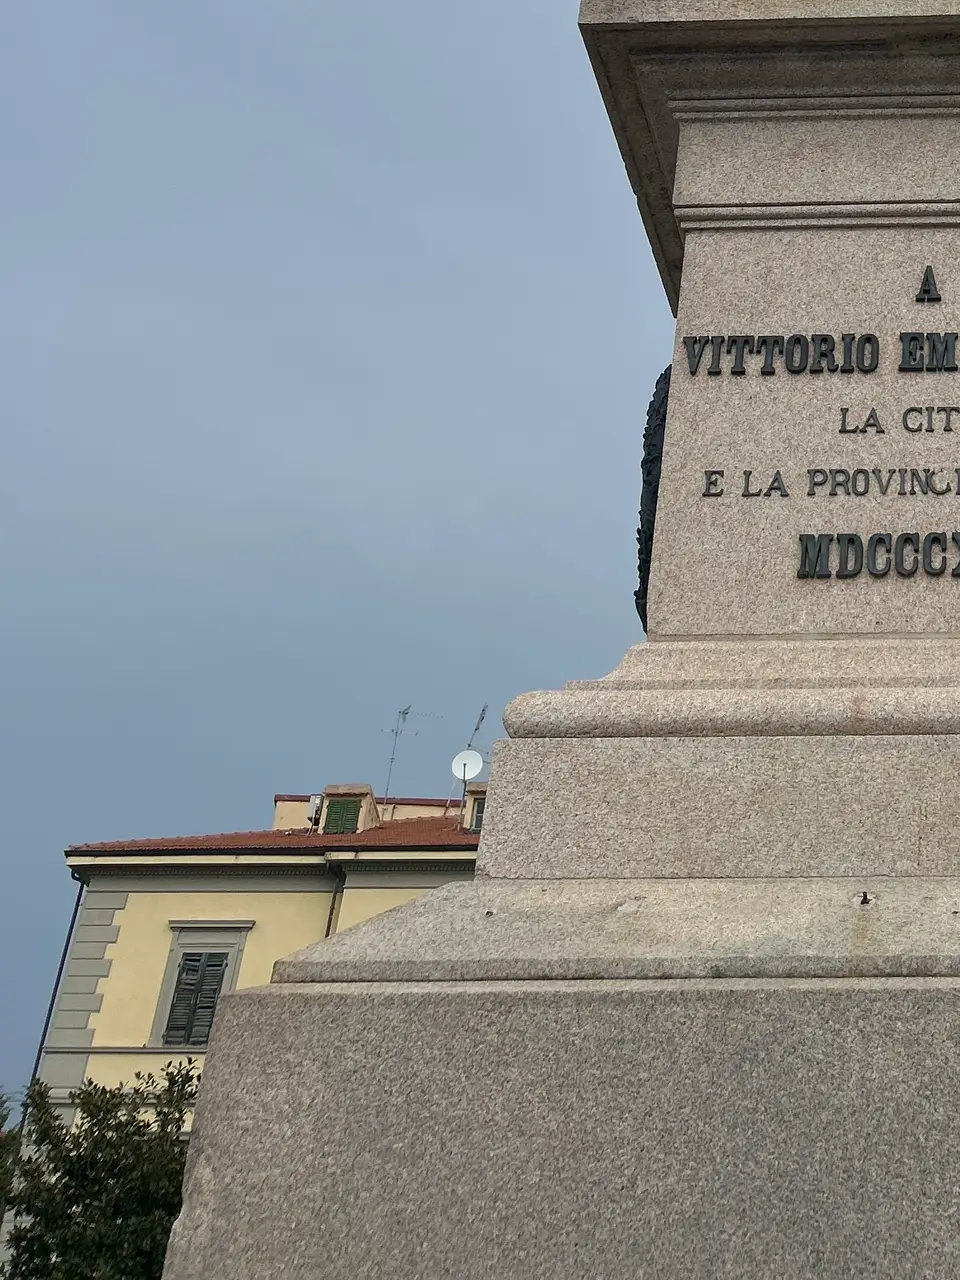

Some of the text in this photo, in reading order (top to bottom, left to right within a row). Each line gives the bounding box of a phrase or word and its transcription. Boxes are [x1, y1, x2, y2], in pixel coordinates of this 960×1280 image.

[915, 265, 942, 302] A
[683, 333, 880, 375] VITTORIO
[839, 407, 885, 433] LA
[702, 470, 725, 497] E
[741, 470, 789, 497] LA
